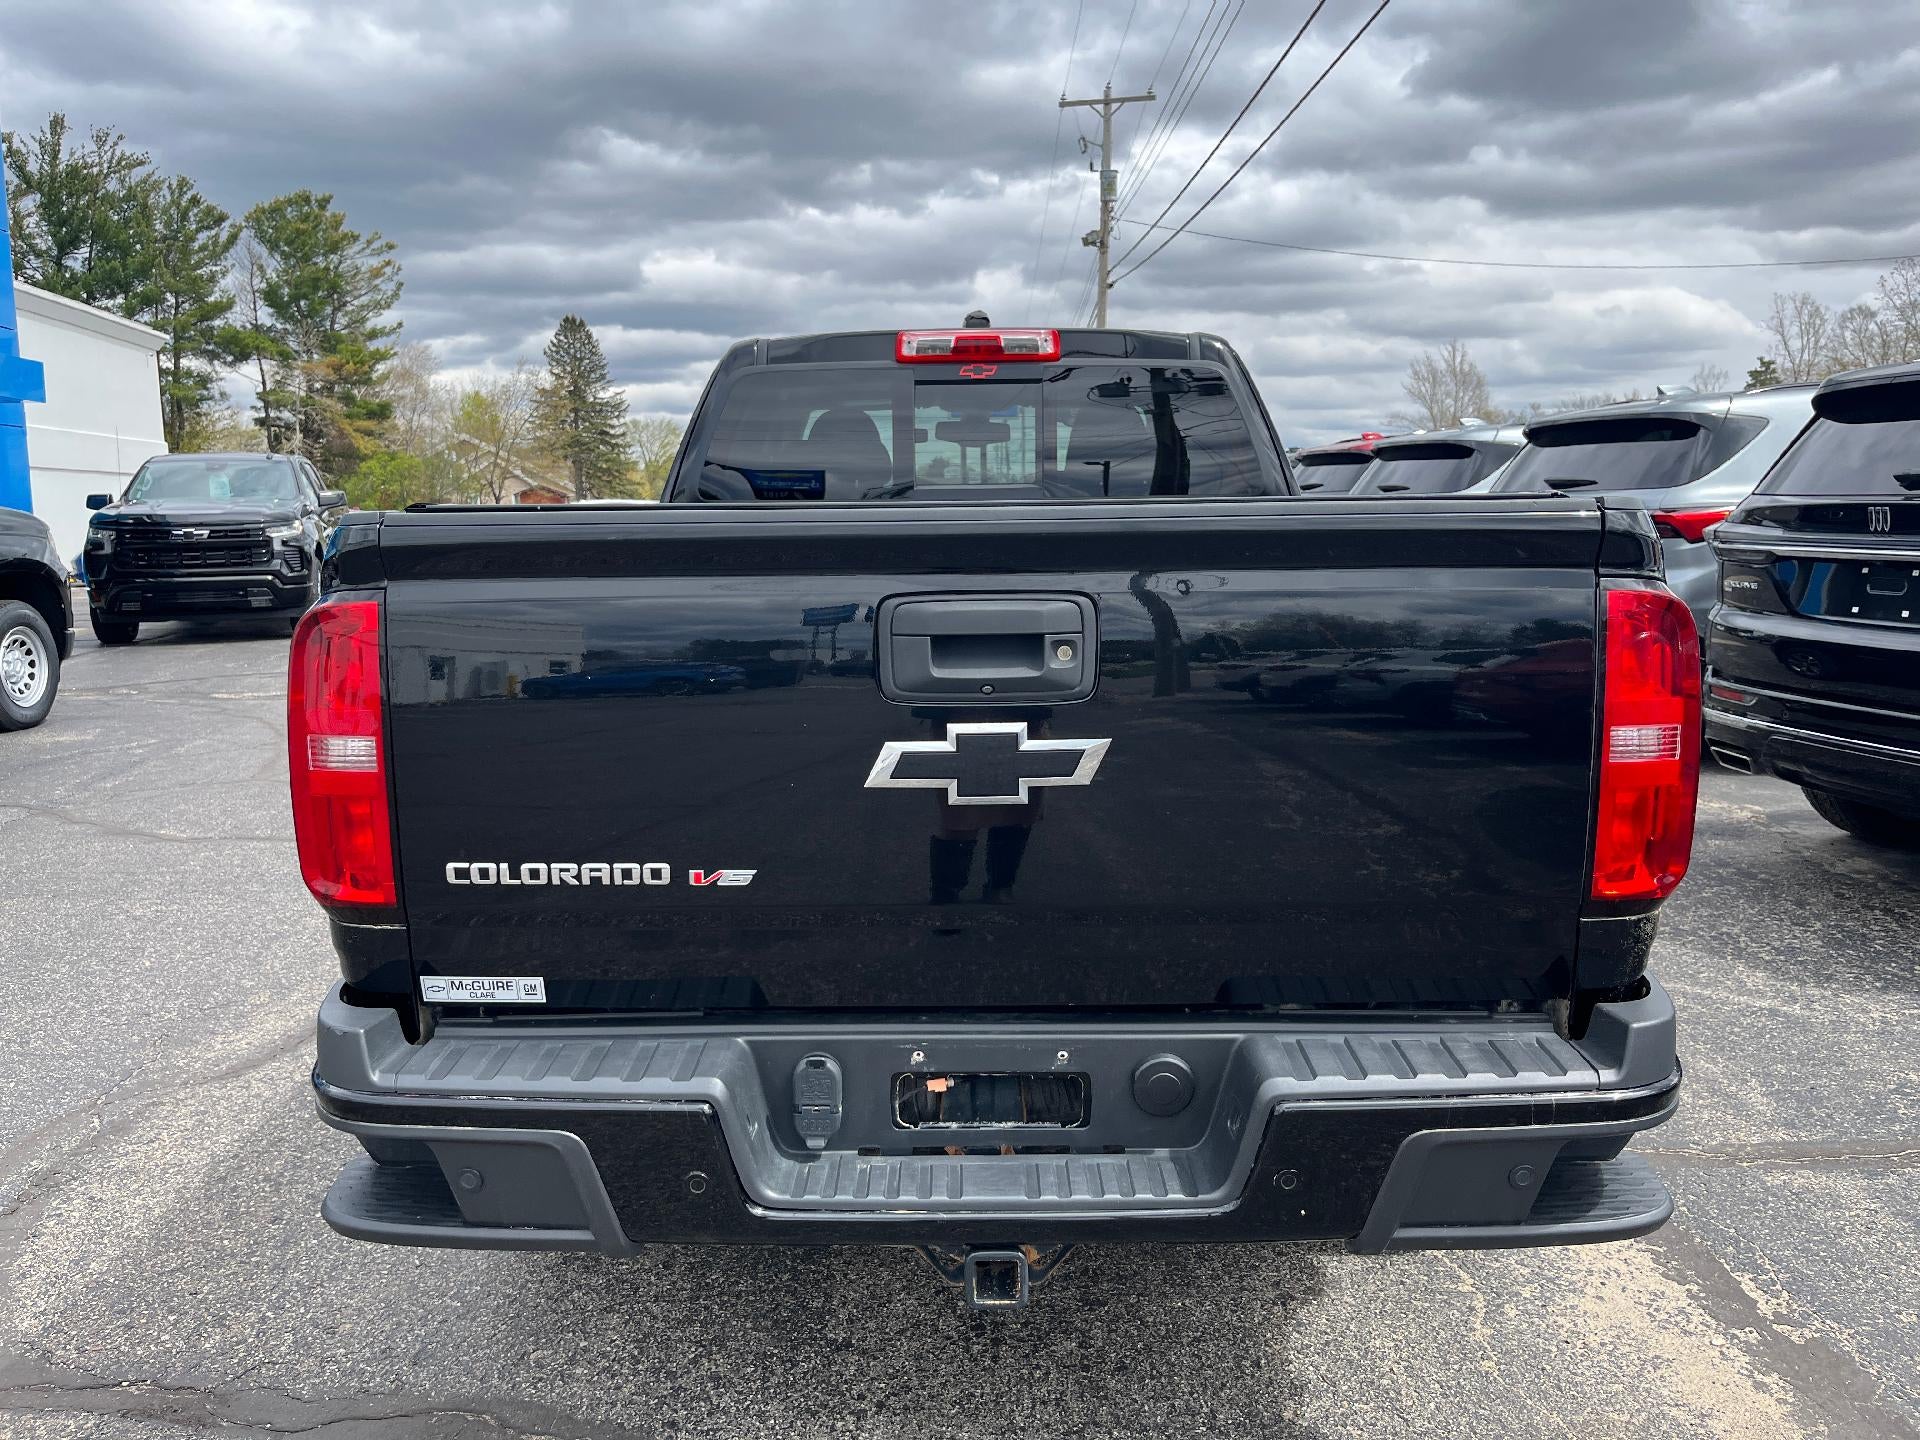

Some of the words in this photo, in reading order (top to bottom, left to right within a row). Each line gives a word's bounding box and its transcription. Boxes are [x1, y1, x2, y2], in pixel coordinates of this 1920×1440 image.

[446, 862, 671, 885] COLORADO
[688, 869, 758, 886] V6
[450, 980, 514, 991] McGUIRE
[523, 983, 538, 993] GM
[469, 991, 497, 999] CLARE
